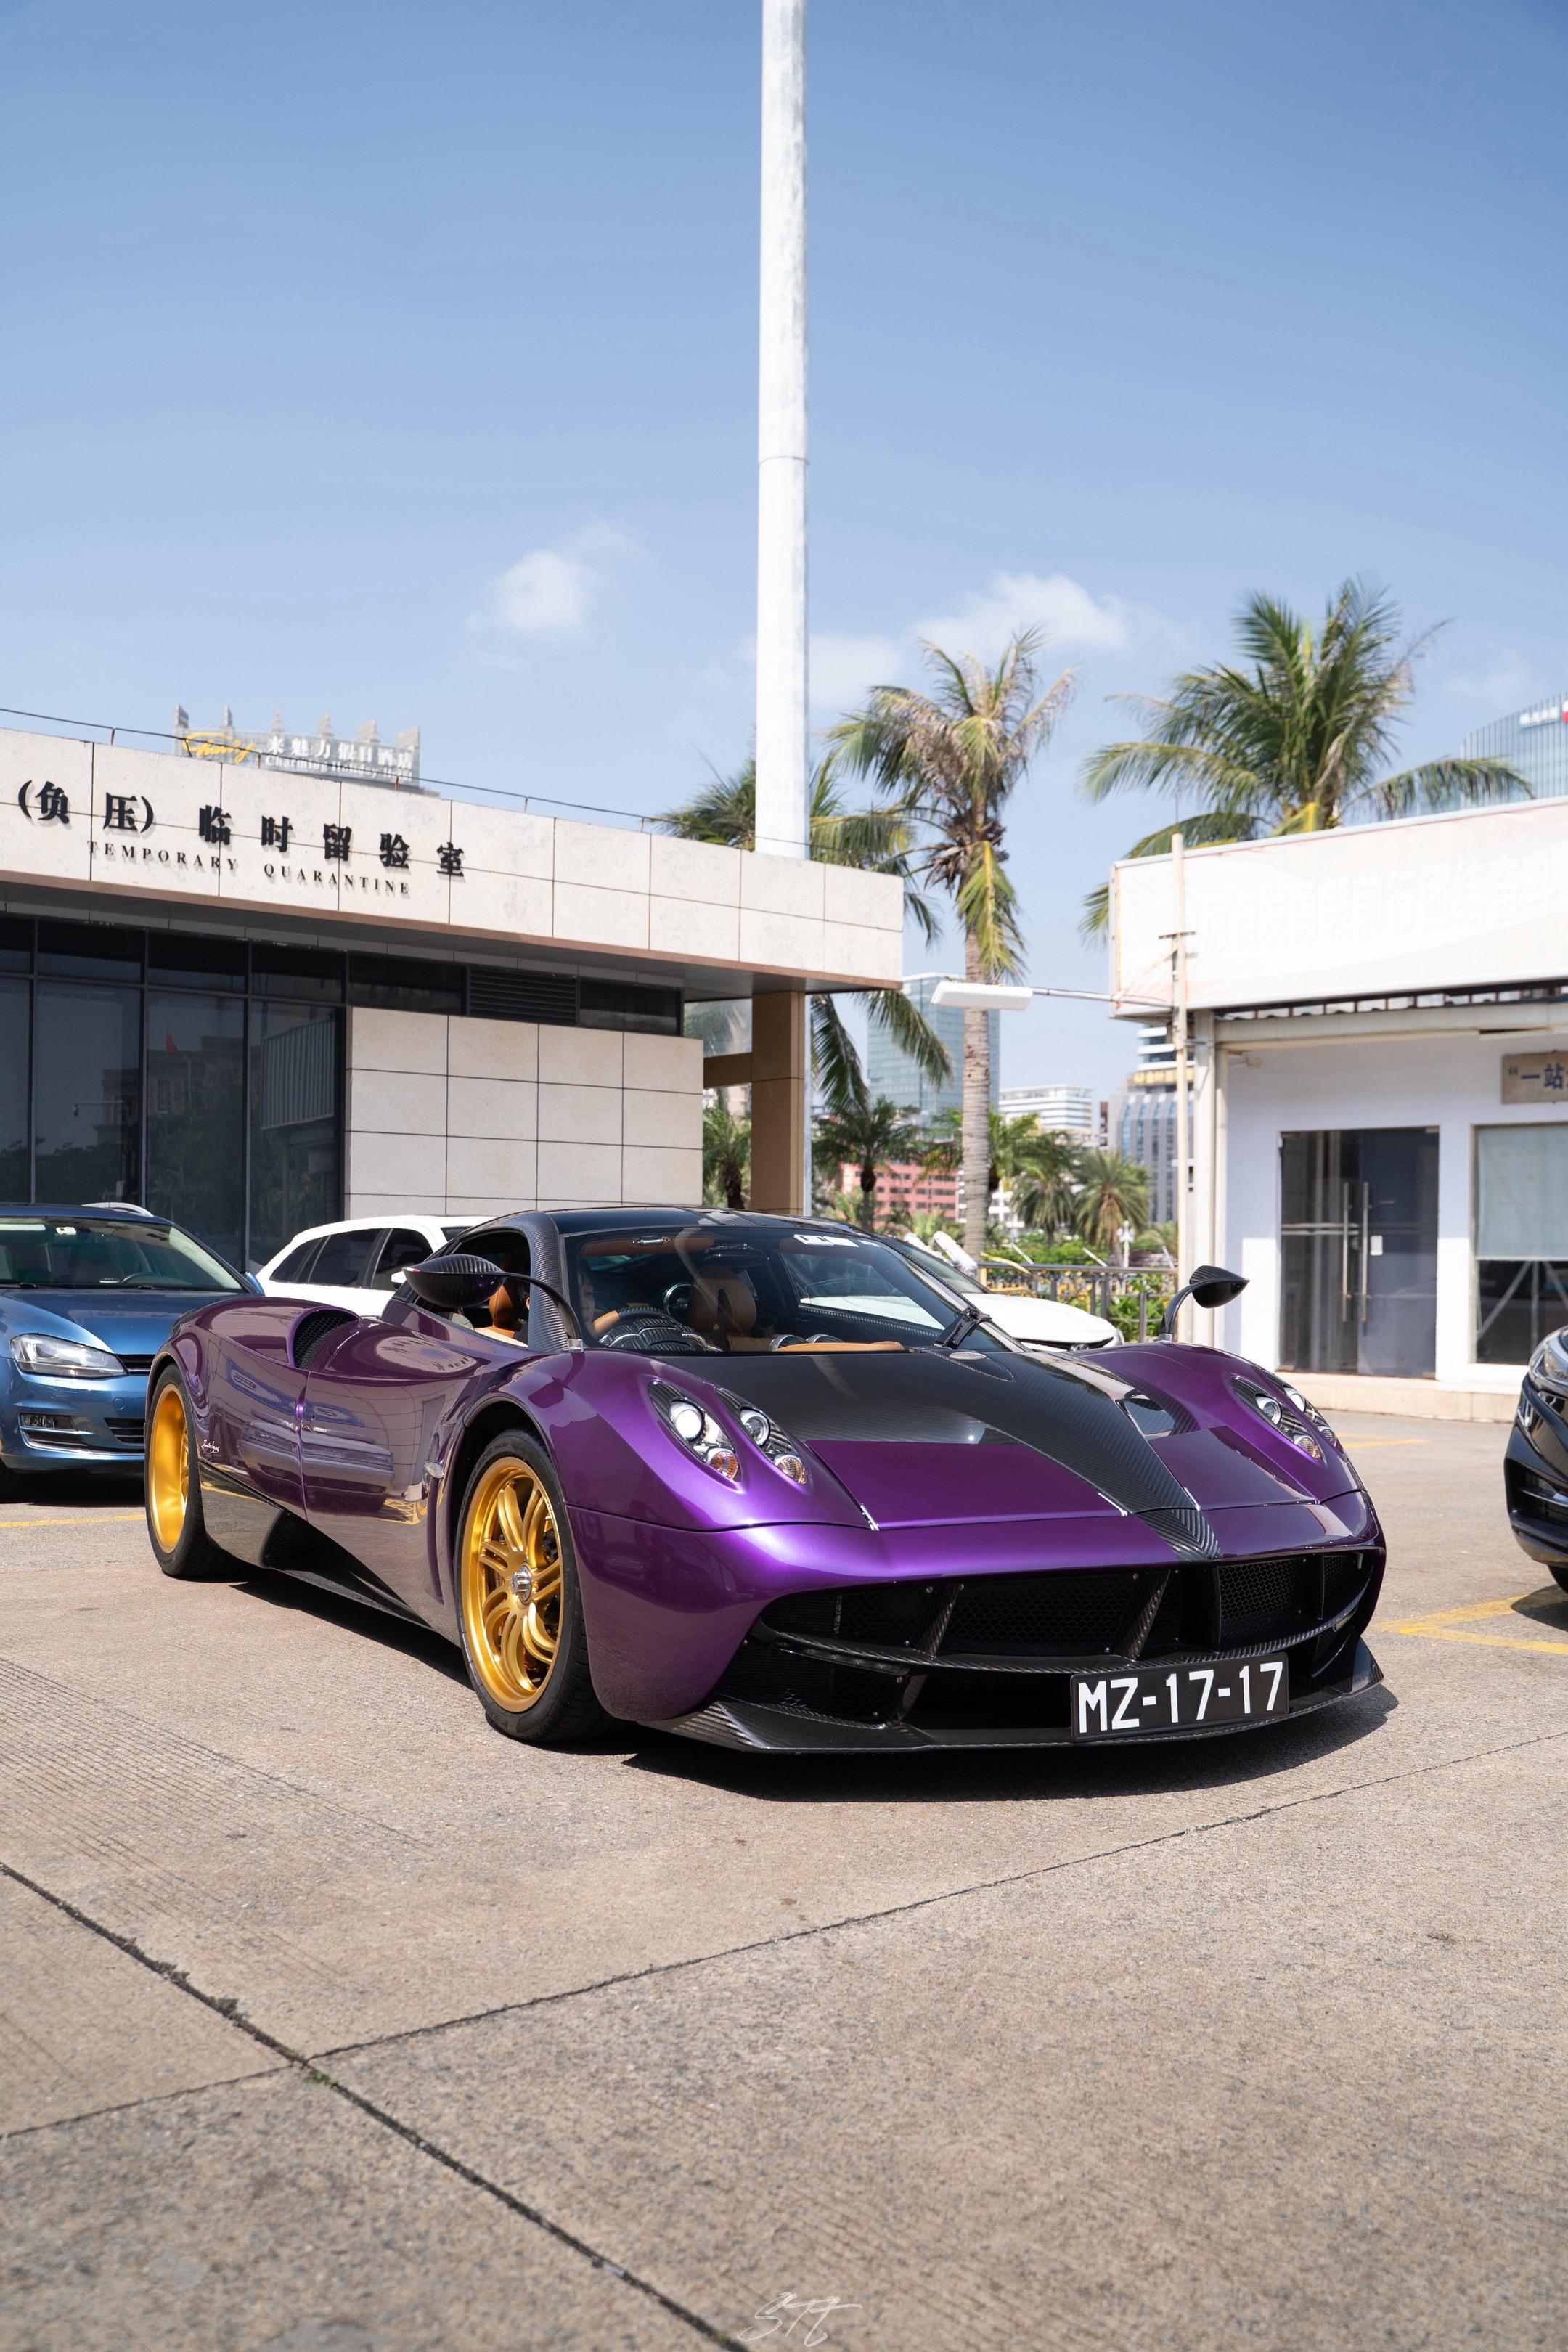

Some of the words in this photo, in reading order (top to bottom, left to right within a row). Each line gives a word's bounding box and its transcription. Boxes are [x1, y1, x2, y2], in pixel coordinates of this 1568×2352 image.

[265, 755, 327, 773] Charming
[87, 841, 237, 870] TEMPORARY
[264, 863, 409, 894] QUARANTINE
[1508, 1062, 1568, 1090] “一站
[1079, 1661, 1283, 1734] MZ-17-17
